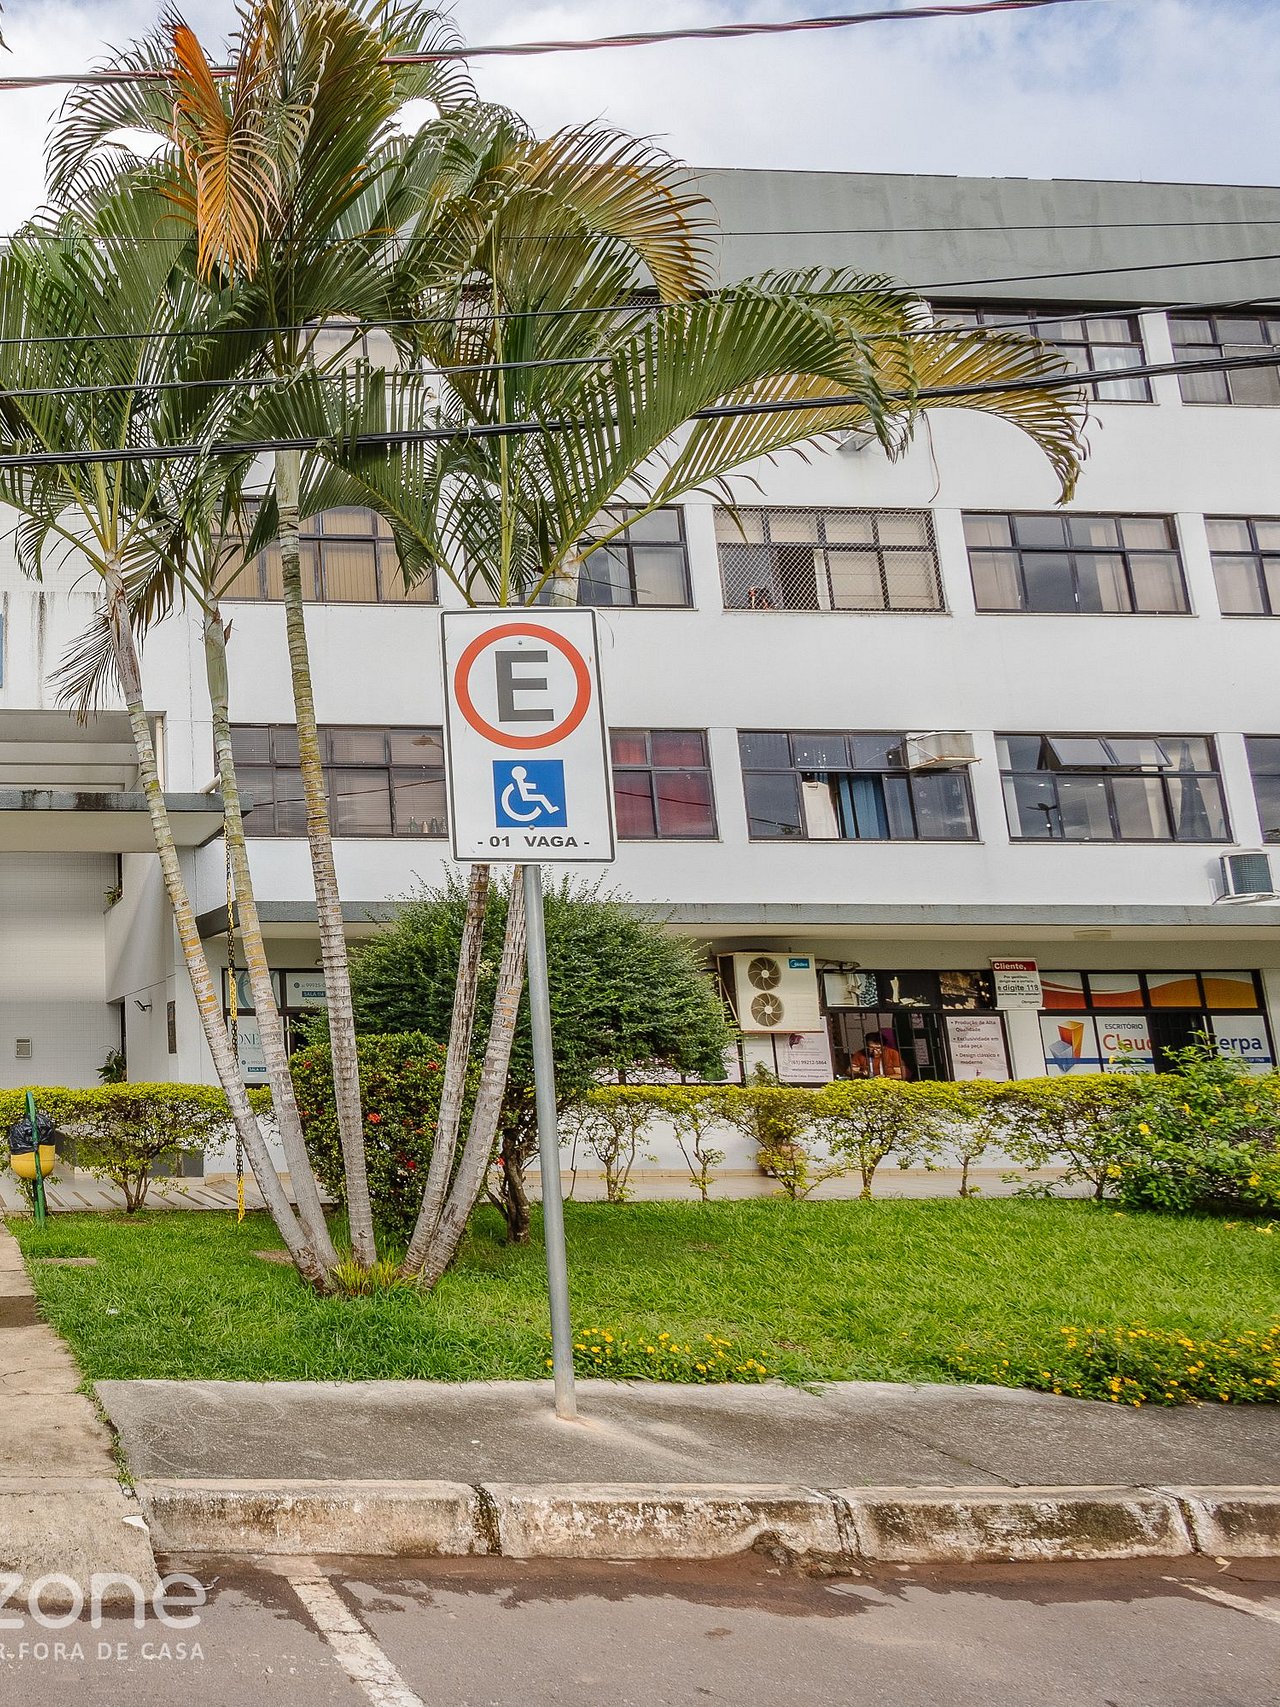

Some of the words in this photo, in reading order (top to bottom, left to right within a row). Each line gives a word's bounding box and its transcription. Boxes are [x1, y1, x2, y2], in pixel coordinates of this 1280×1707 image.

[494, 650, 554, 722] E
[488, 836, 511, 848] 01
[523, 836, 579, 848] VAGA
[994, 963, 1027, 971] Cliente,
[1003, 984, 1025, 992] digite
[1218, 1037, 1263, 1055] erpa
